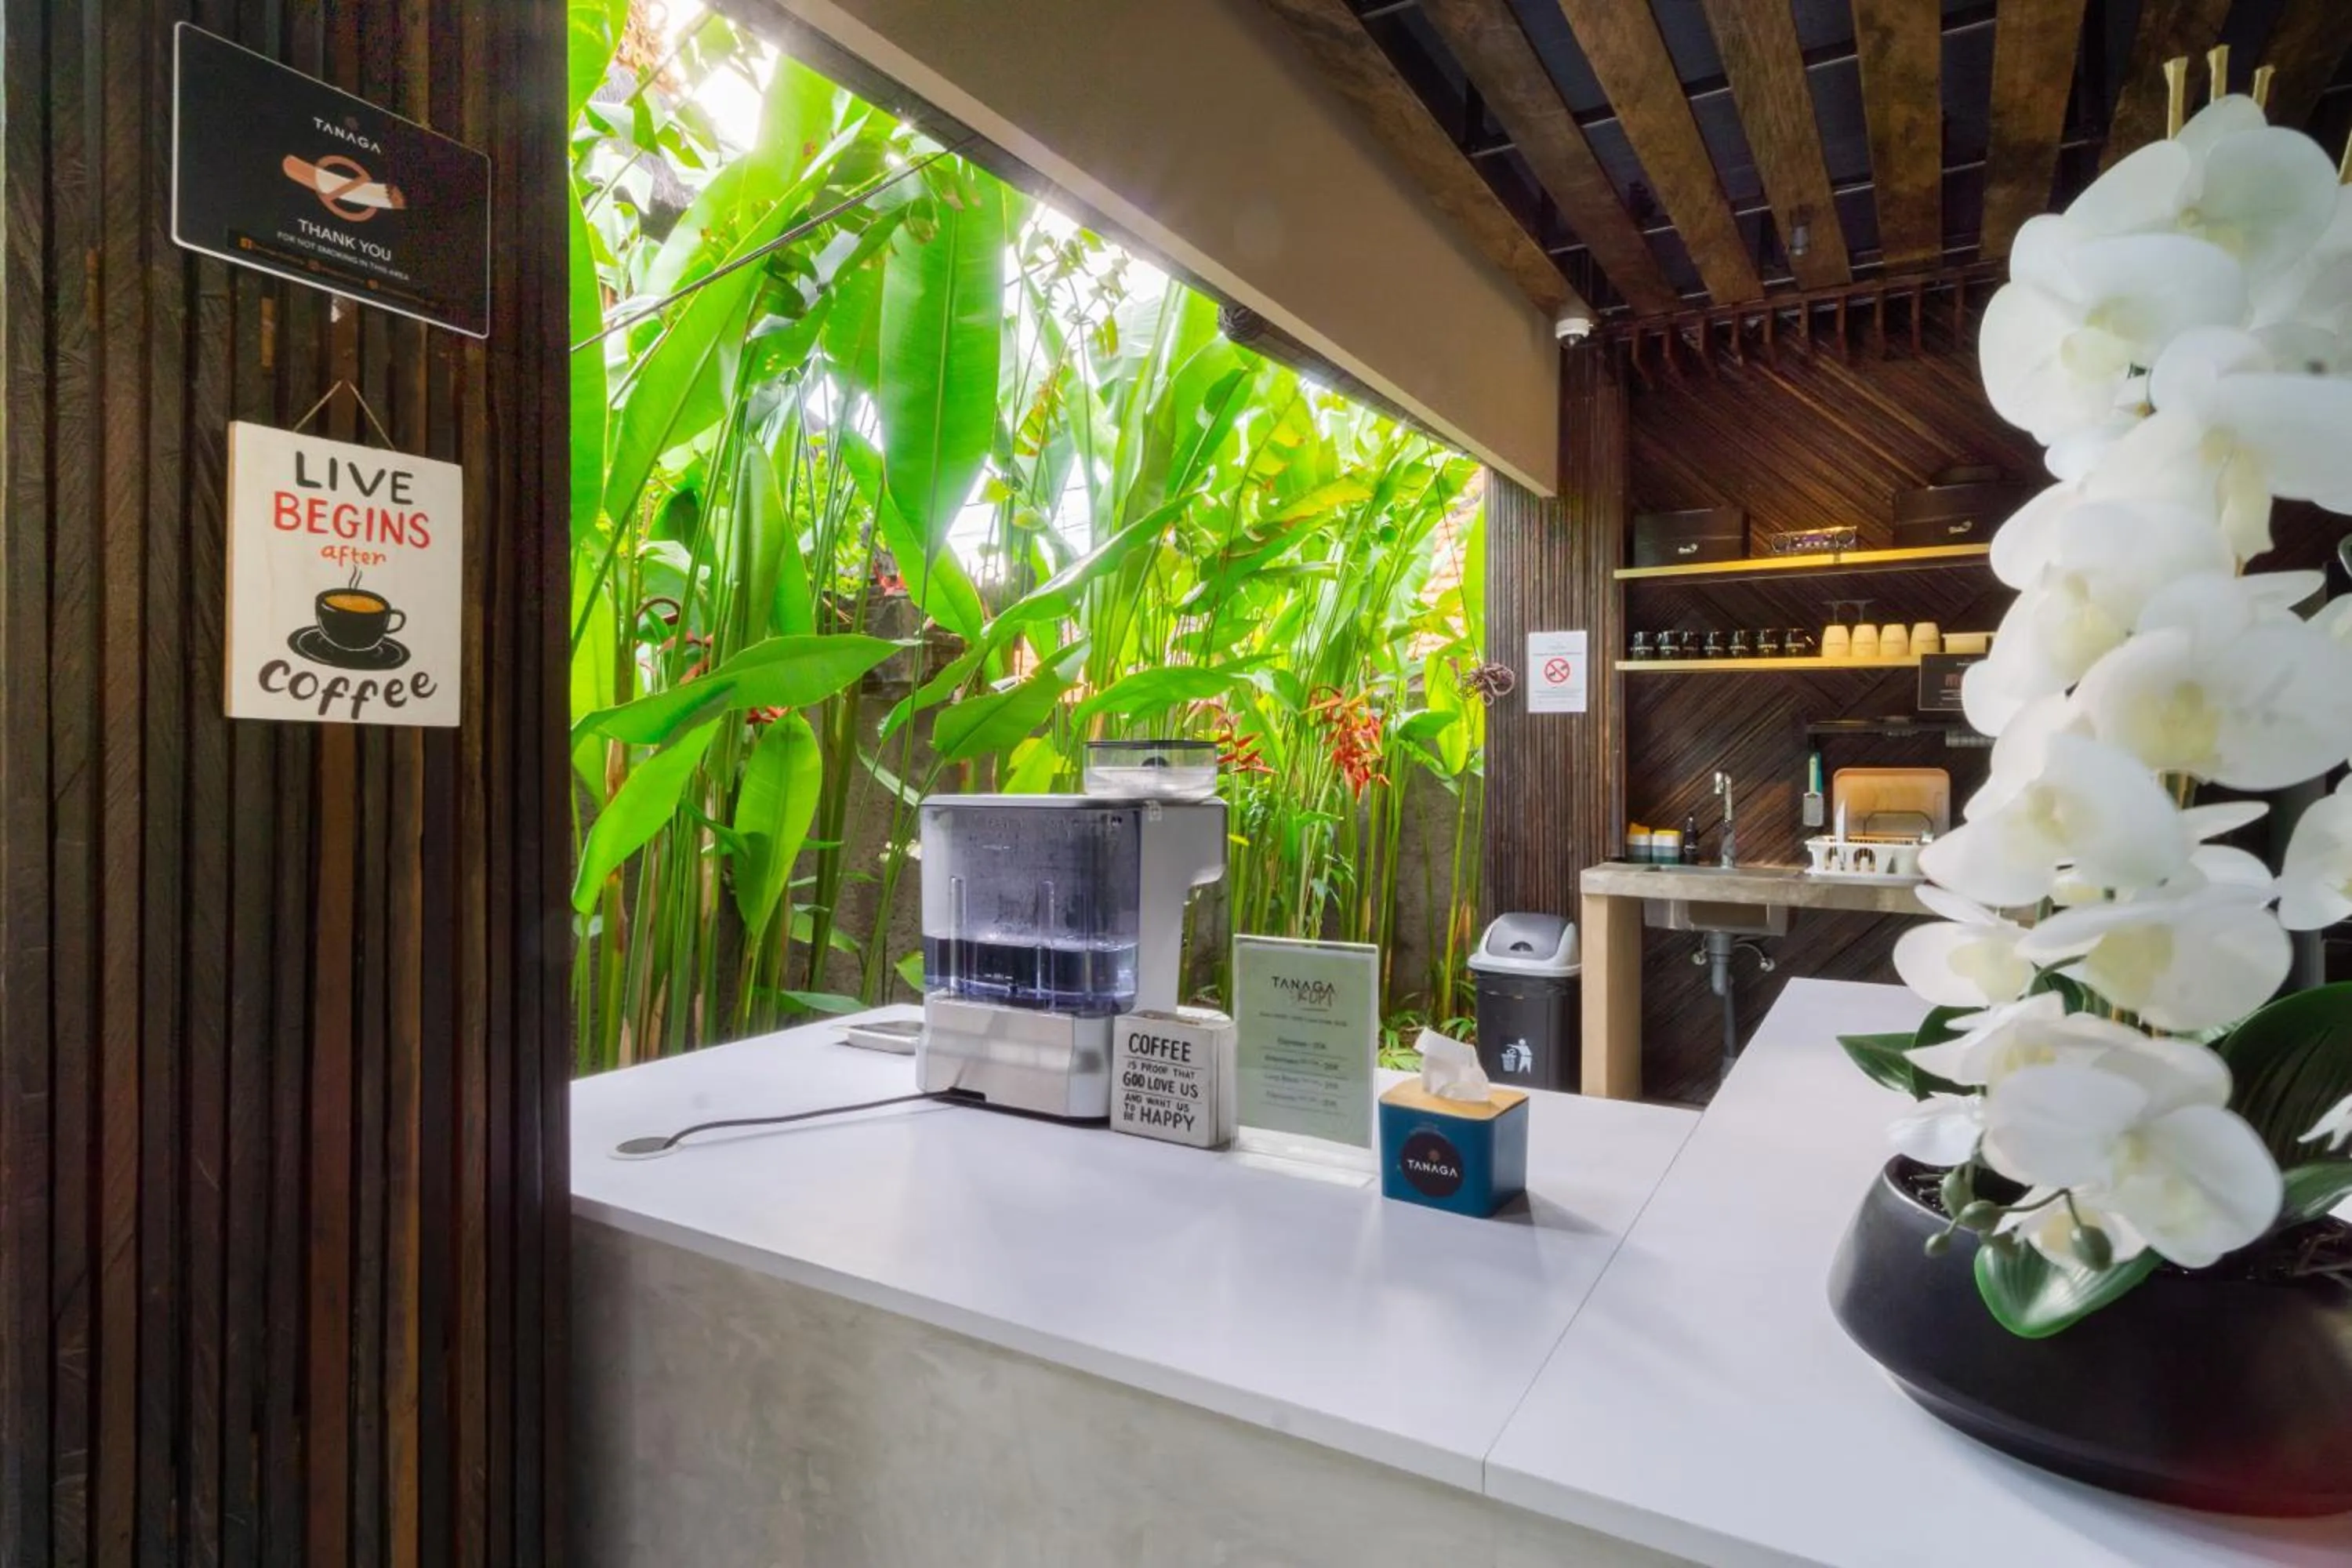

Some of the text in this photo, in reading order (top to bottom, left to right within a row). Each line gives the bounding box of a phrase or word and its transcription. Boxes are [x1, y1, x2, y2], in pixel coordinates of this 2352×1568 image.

[314, 116, 381, 154] TANAGA
[277, 231, 295, 242] FOR
[297, 238, 315, 250] NOT
[318, 245, 358, 264] SMOKING
[359, 259, 368, 267] IN
[297, 218, 391, 261] THANK YOU
[295, 451, 414, 505] LIVE
[273, 491, 431, 550] BEGINS
[320, 544, 387, 568] after
[1271, 975, 1336, 994] TANAGA
[1128, 1033, 1192, 1062] COFFEE
[1127, 1061, 1196, 1080] IS PROOF THAT
[1123, 1071, 1199, 1099] GOD LOVE US
[1124, 1093, 1190, 1112] AND WANT US
[1124, 1102, 1135, 1112] TO
[1140, 1105, 1195, 1132] HAPPY
[1406, 1159, 1458, 1178] TANAGA
